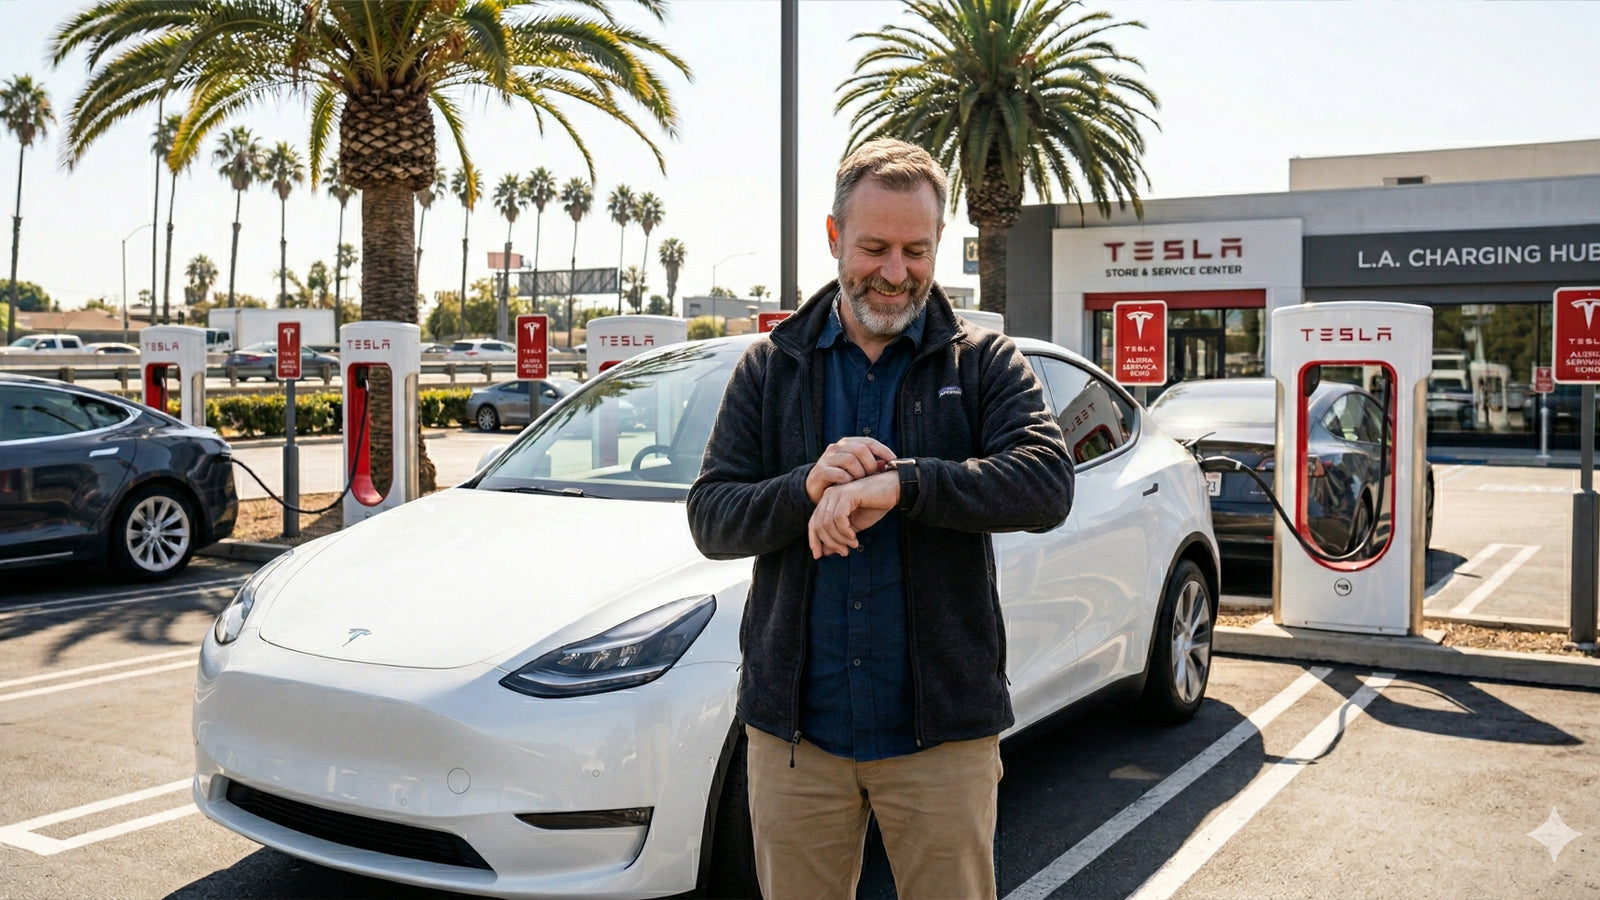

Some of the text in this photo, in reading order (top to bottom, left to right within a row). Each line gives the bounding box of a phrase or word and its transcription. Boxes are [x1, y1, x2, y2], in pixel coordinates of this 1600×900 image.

[1103, 237, 1242, 262] TESLA
[1358, 243, 1600, 268] L.A. CHARGING HUB
[1105, 265, 1242, 277] STORE & SERVICE CENTER
[1300, 327, 1391, 341] TESLA
[145, 342, 179, 351] TESLA
[347, 339, 390, 350] TESLA
[599, 335, 654, 346] TESLA
